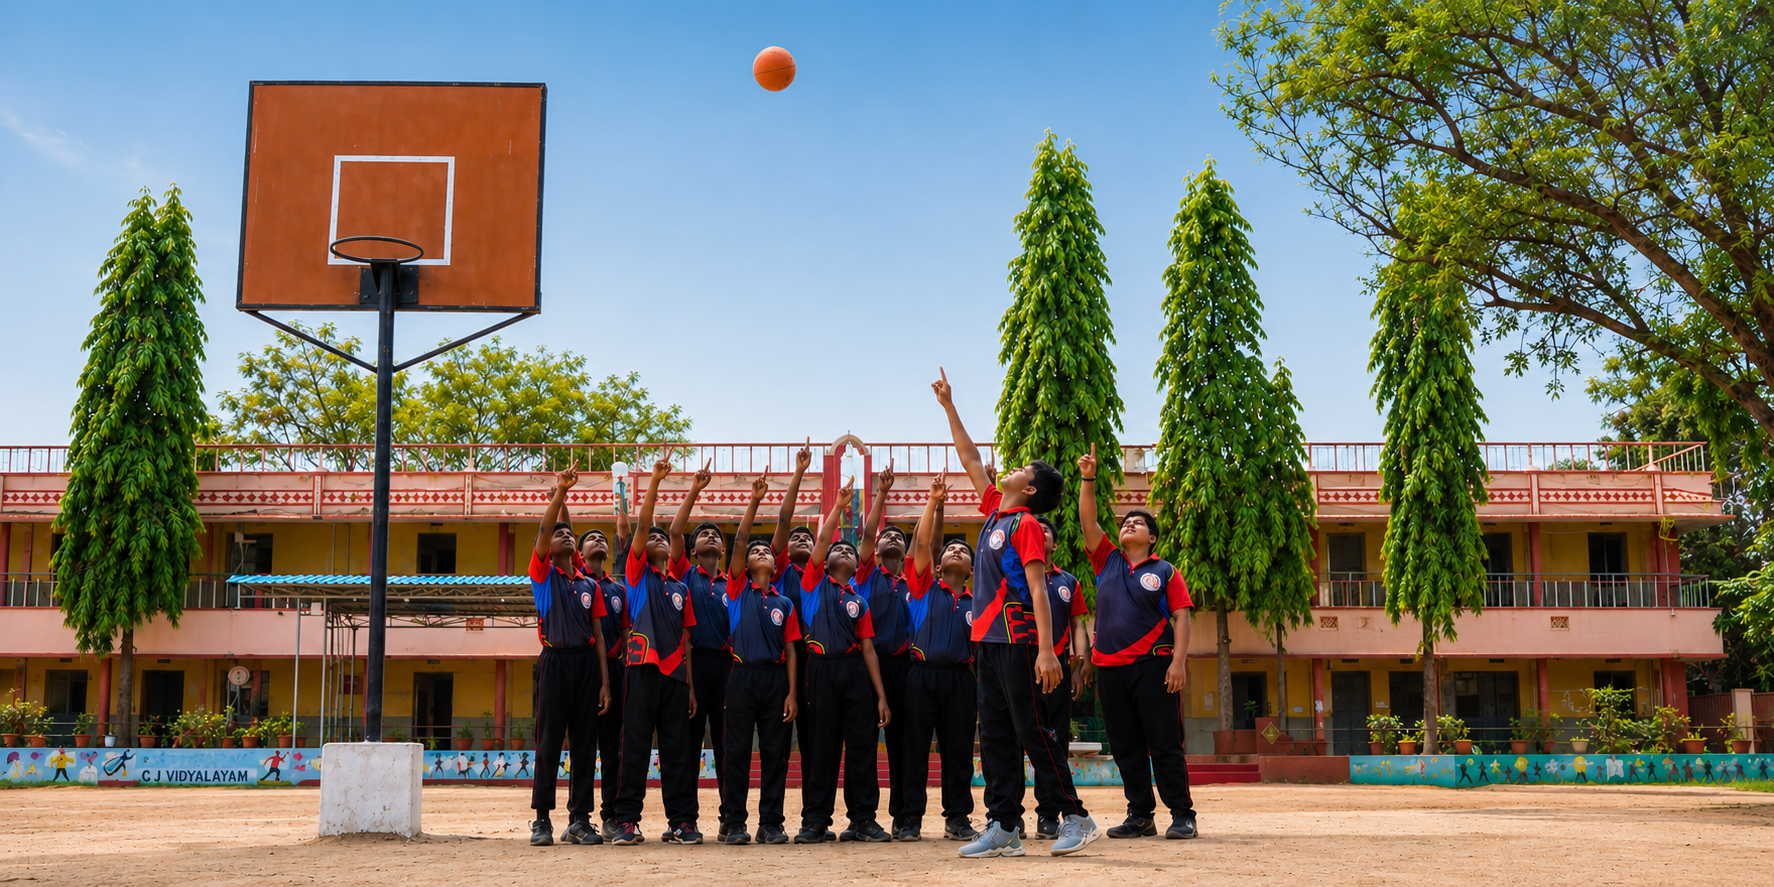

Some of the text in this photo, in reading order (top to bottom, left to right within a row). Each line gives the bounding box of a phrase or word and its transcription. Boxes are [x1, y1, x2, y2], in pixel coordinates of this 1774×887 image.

[142, 770, 248, 782] C J VIDYALAYAM
